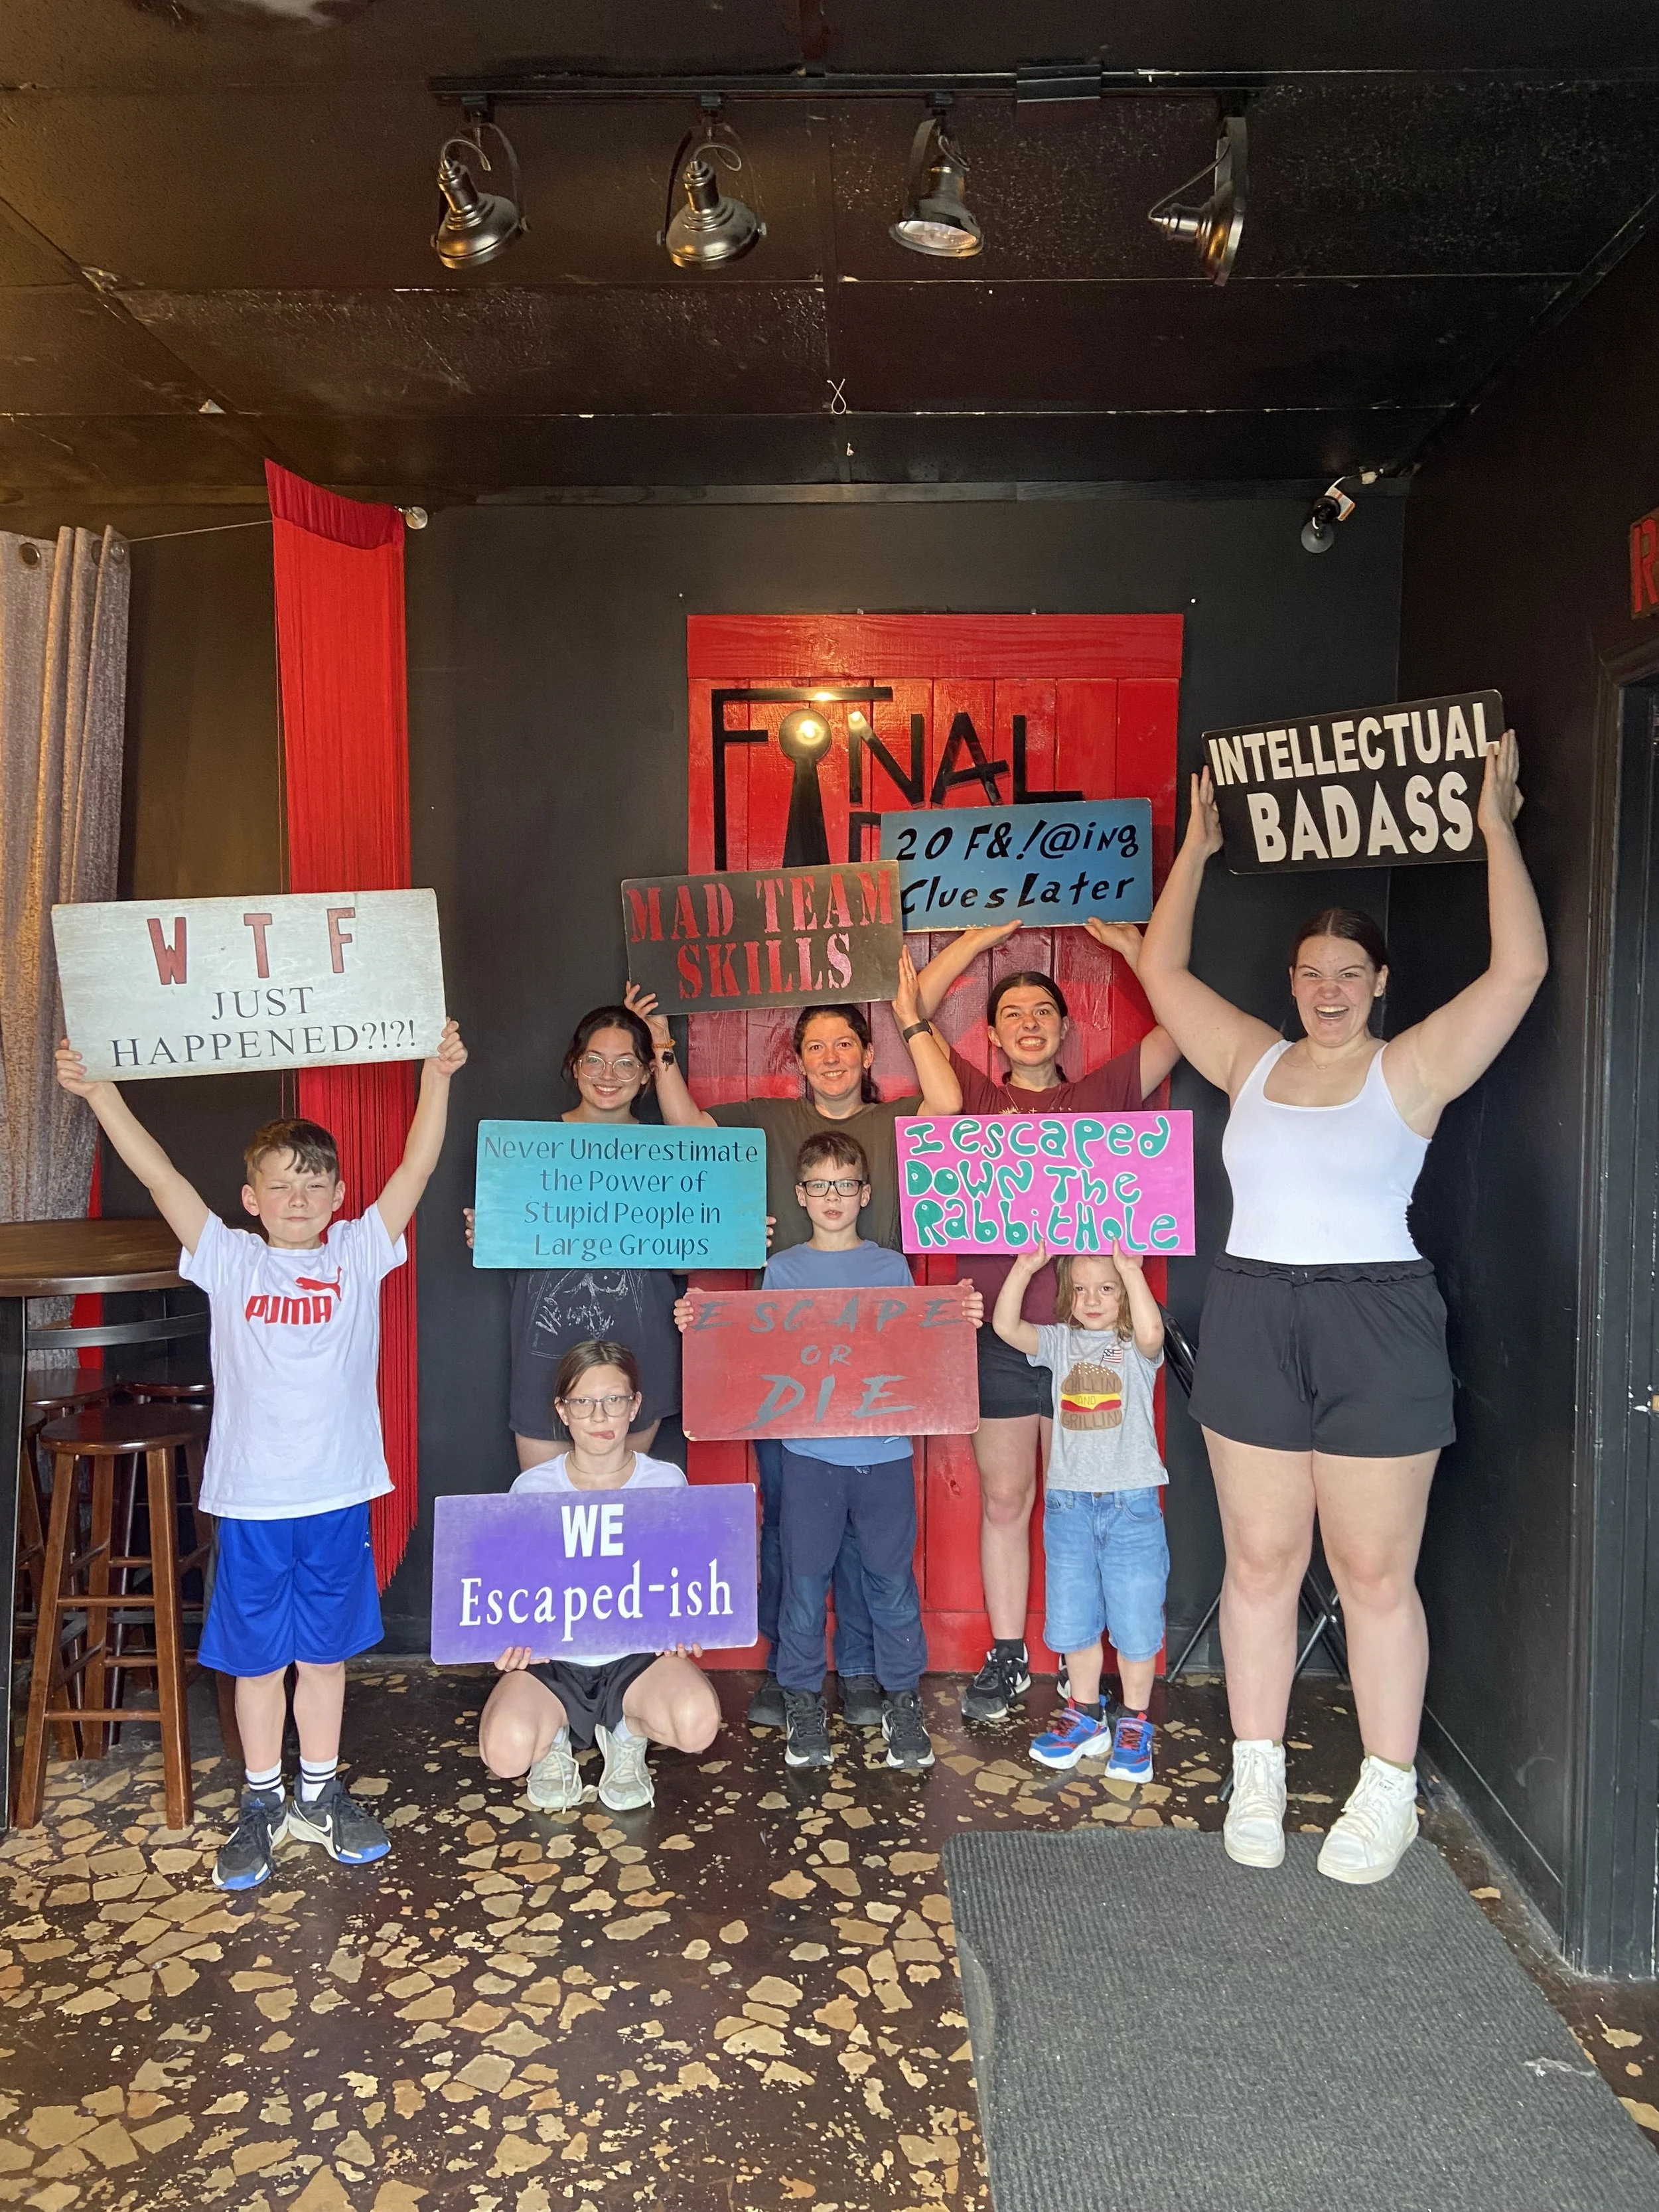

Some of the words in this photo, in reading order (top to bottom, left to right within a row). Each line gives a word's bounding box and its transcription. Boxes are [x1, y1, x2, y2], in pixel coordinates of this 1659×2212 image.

[1208, 702, 1500, 786] INTELLECTUAL
[1247, 771, 1473, 863] BADASS
[897, 826, 953, 861] 20
[626, 883, 734, 942] MAD
[756, 870, 894, 933] TEAM
[901, 875, 1009, 915] Clues
[1017, 871, 1135, 908] Later
[677, 932, 852, 999] SKILLS
[212, 987, 314, 1020] JUST
[109, 1019, 416, 1067] HAPPENED?!?!
[484, 1136, 563, 1159] Never
[570, 1138, 758, 1163] Underestimate
[904, 1122, 944, 1155] I
[540, 1168, 583, 1192] the
[589, 1169, 674, 1193] Power
[680, 1171, 708, 1193] of
[1044, 1165, 1141, 1206] The
[524, 1201, 608, 1229] Stupid
[614, 1201, 694, 1229] People
[701, 1203, 721, 1224] in
[535, 1234, 613, 1262] Large
[619, 1234, 709, 1261] Groups
[246, 1295, 331, 1325] PUMA
[691, 1294, 965, 1333] ESCAPE
[800, 1344, 852, 1366] OR
[731, 1374, 916, 1434] DIE
[1078, 1396, 1096, 1405] AND
[561, 1503, 624, 1558] WE
[459, 1558, 733, 1642] Escaped-ish
